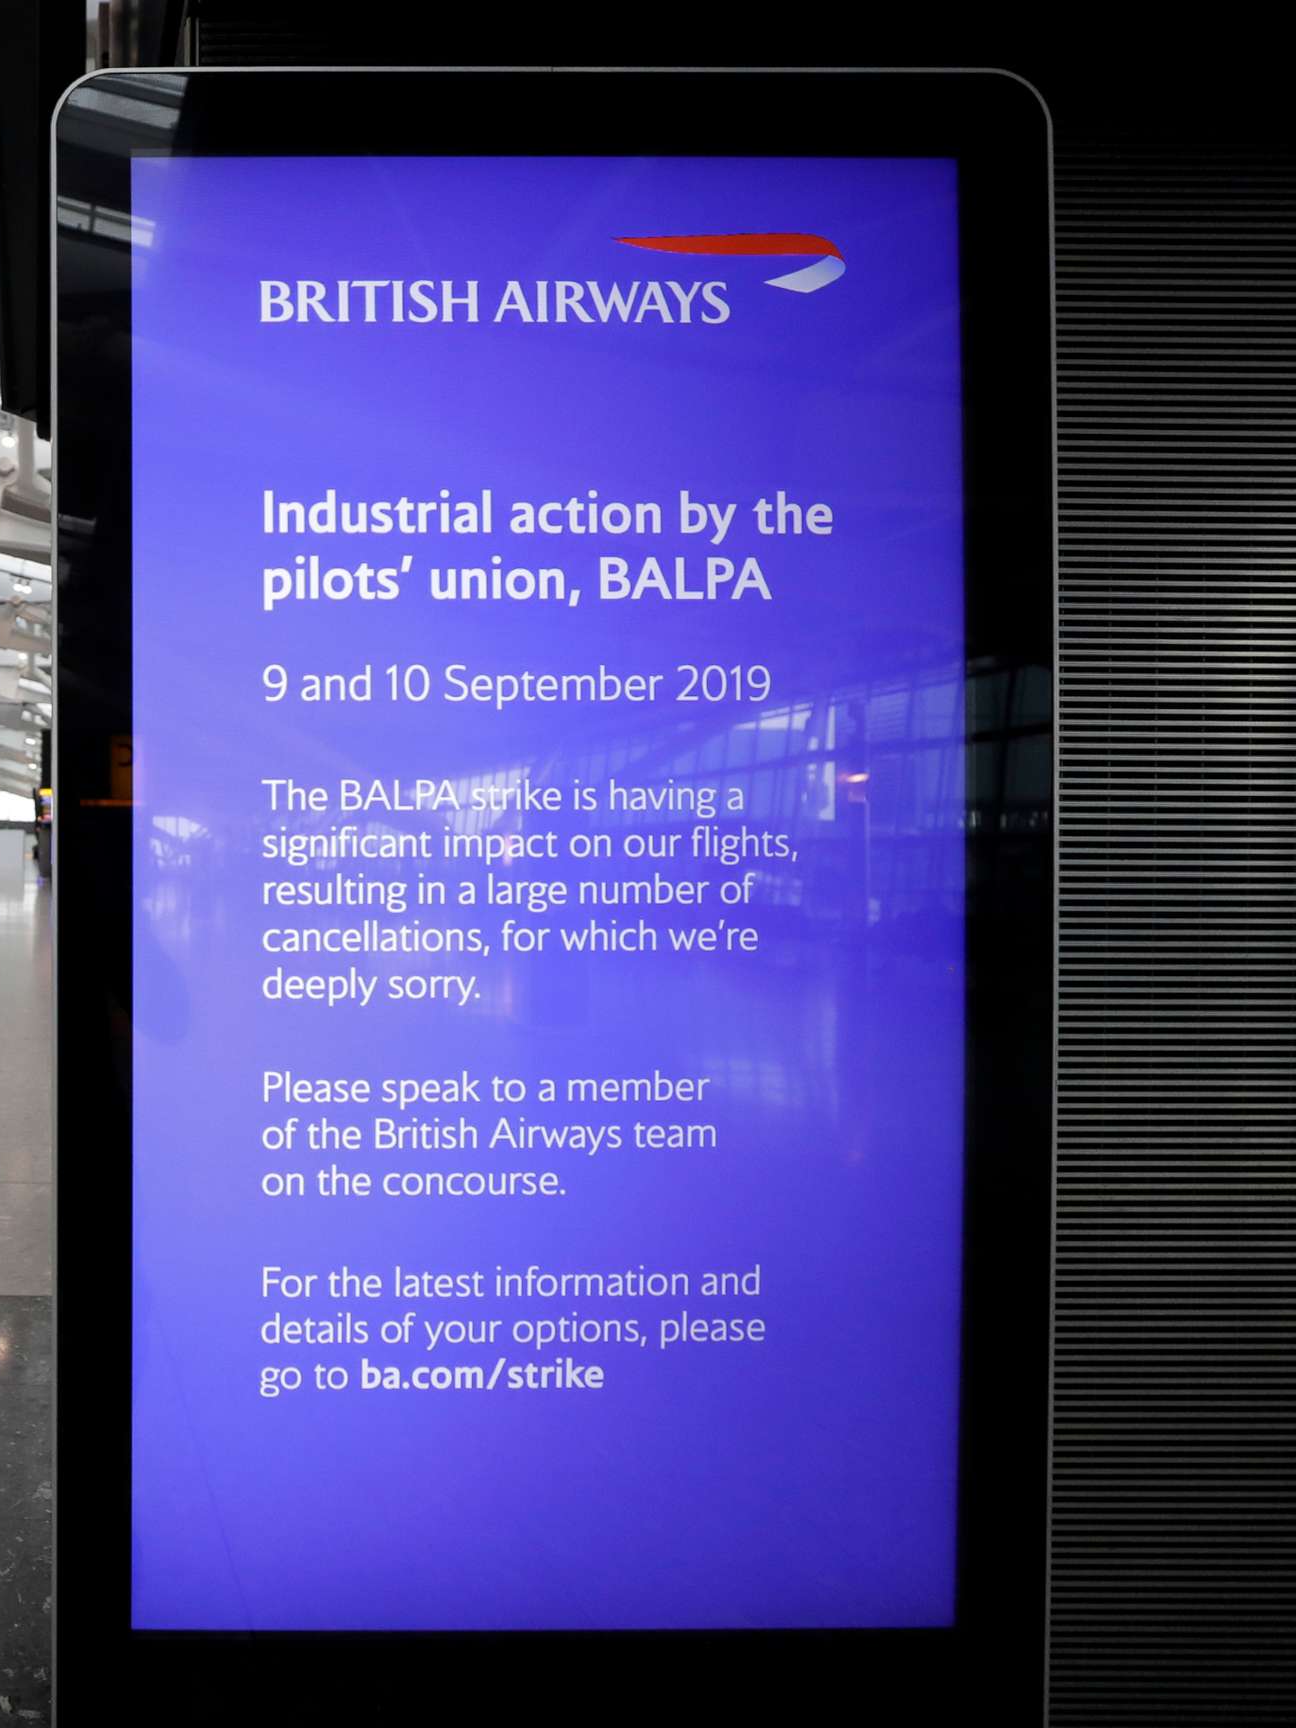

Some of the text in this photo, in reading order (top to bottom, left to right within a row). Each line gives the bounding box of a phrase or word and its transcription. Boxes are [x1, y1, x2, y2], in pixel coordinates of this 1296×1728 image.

[259, 279, 730, 324] BRITISH AIRWAYS
[263, 489, 833, 545] Industrial action by the
[263, 555, 772, 611] pilots’ union, BALPA
[262, 664, 771, 710] 9 and 10 September 2019
[263, 779, 744, 818] The BALPA strike is having a
[262, 826, 798, 865] significant impact on our flights,
[263, 872, 754, 912] resulting in a large number of
[262, 919, 758, 957] cancellations, for which we’re
[262, 968, 481, 1006] deeply sorry.
[263, 1069, 711, 1111] Please speak to a member
[262, 1117, 716, 1156] of the British Airways team
[261, 1163, 566, 1196] on the concourse.
[262, 1263, 761, 1298] For the latest information and
[261, 1310, 766, 1351] details of your options, please
[259, 1357, 604, 1398] go to ba.com/strike
